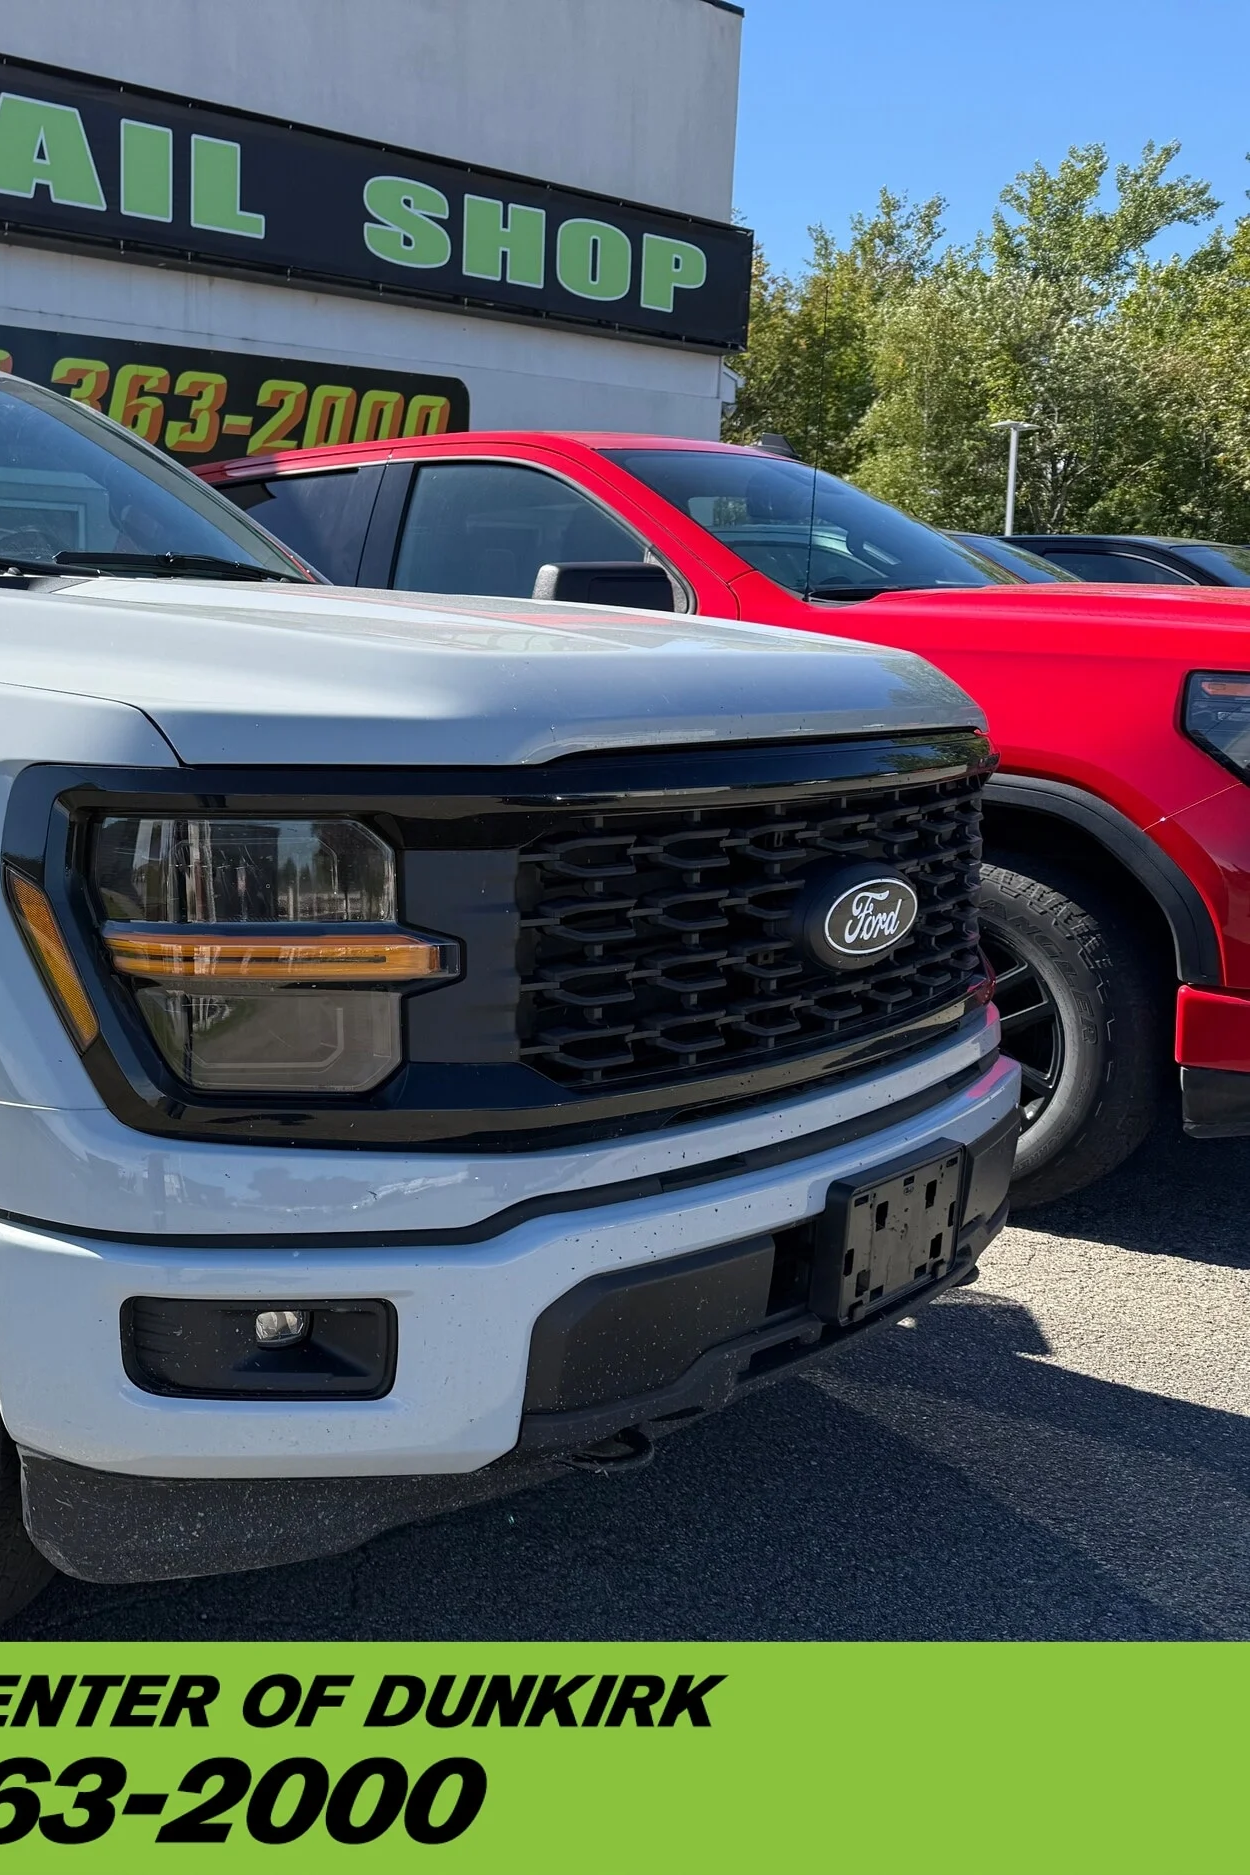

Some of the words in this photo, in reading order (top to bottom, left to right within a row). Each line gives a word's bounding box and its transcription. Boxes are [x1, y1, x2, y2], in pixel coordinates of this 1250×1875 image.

[364, 175, 707, 312] SHOP
[51, 357, 450, 457] 363-2000
[844, 890, 902, 943] Ford
[980, 899, 1098, 1045] ANGLER
